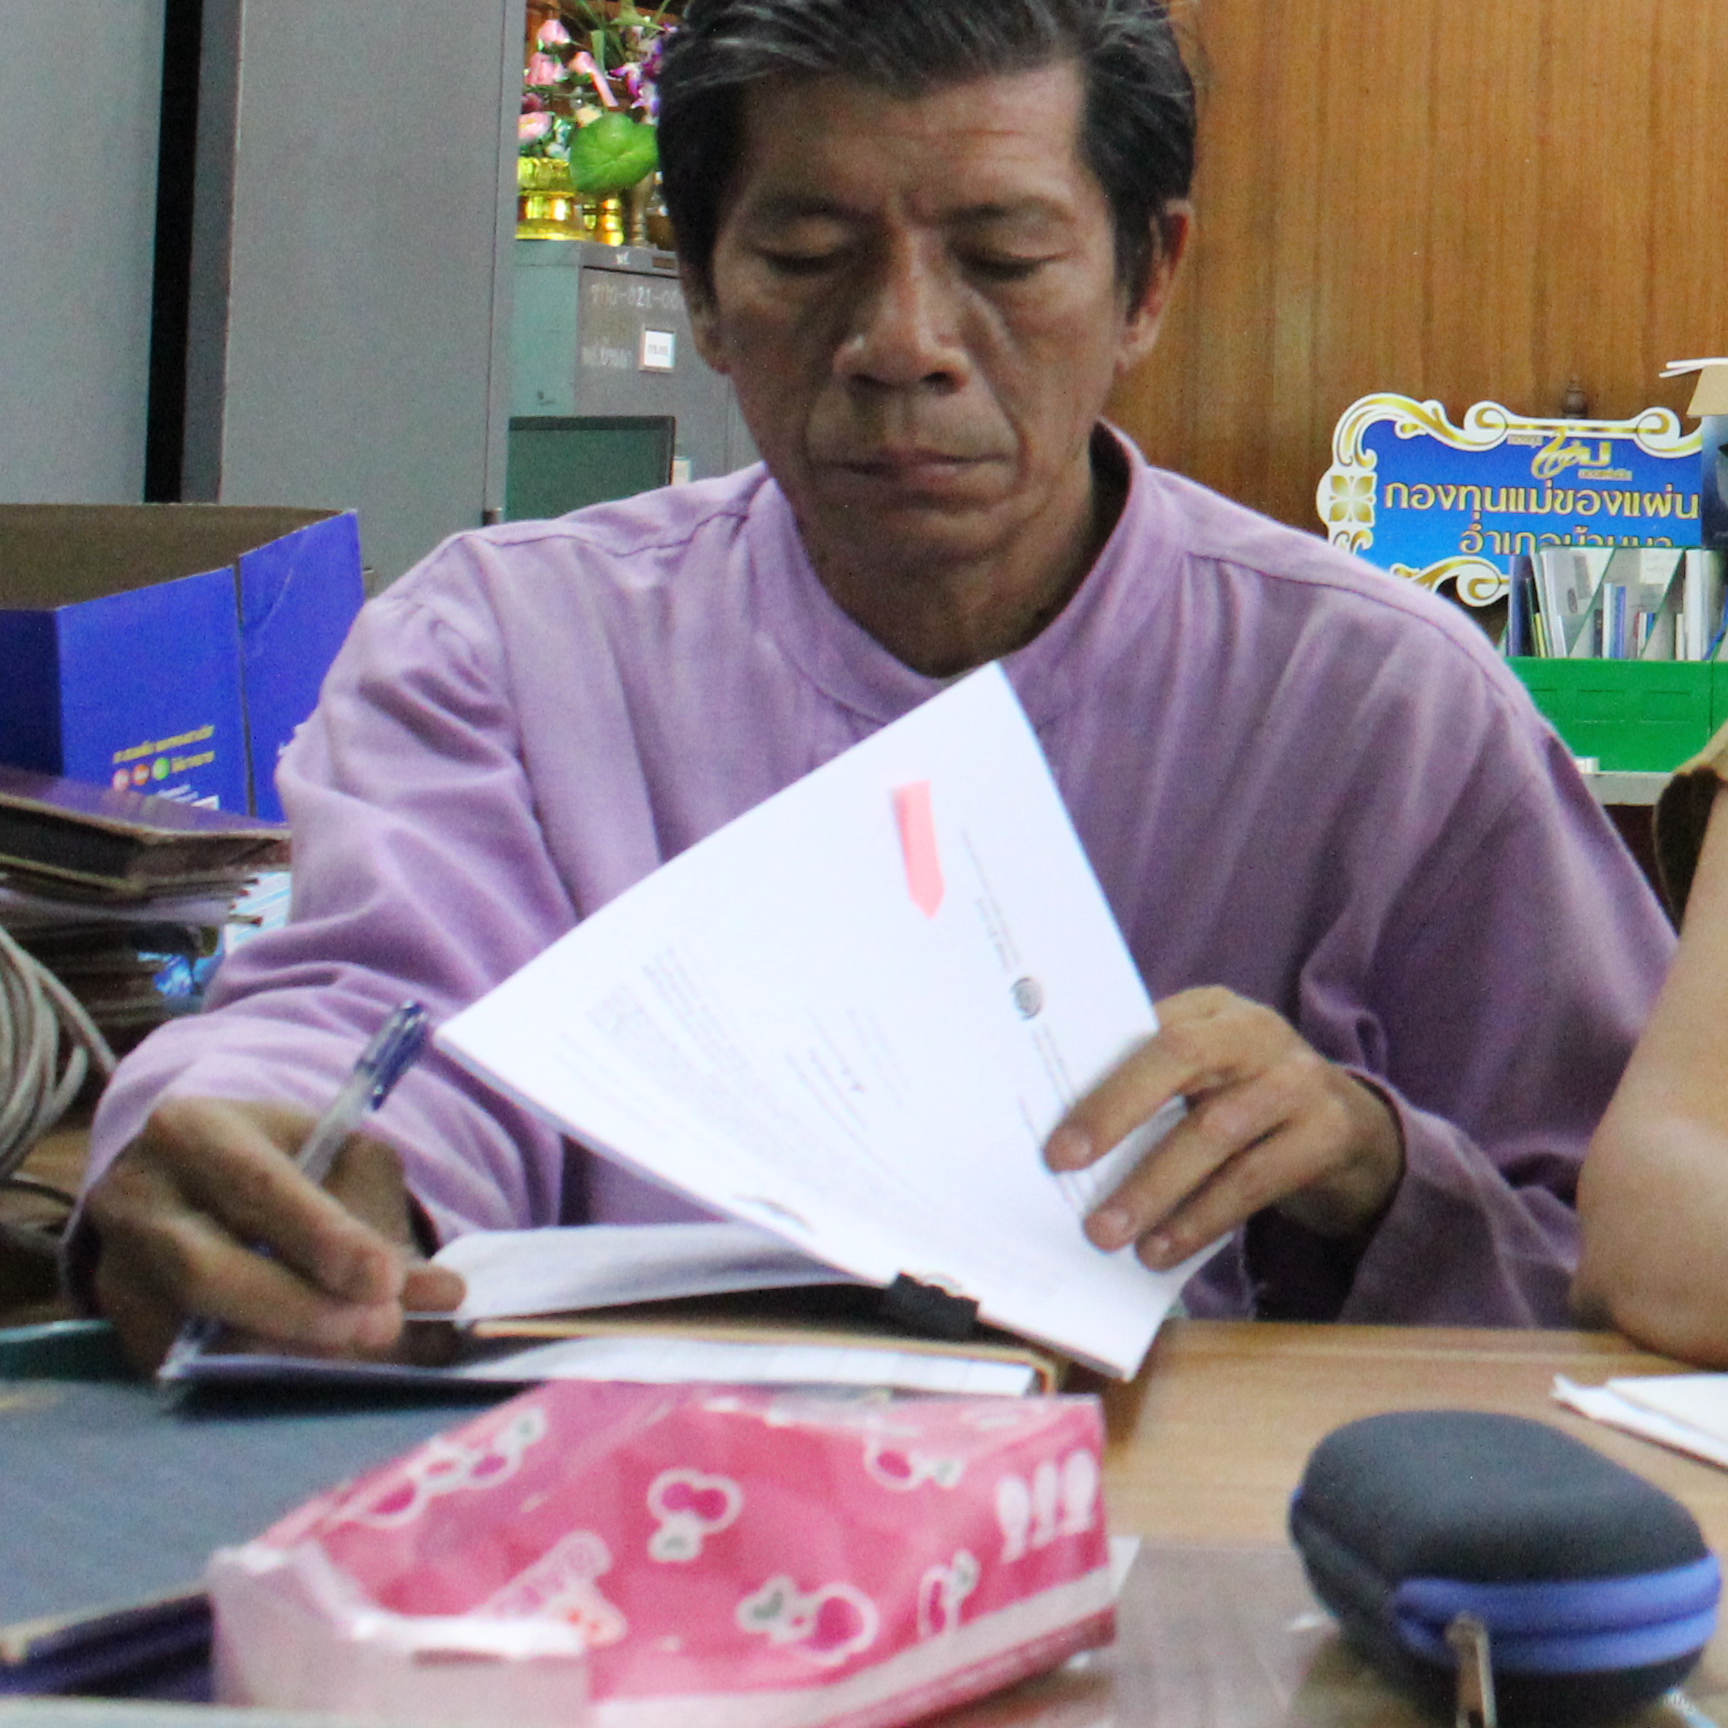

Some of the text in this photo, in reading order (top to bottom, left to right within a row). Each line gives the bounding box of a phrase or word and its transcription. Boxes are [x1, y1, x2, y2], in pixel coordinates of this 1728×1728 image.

[1382, 478, 1700, 522] กองทุนแม่ของแผ่น
